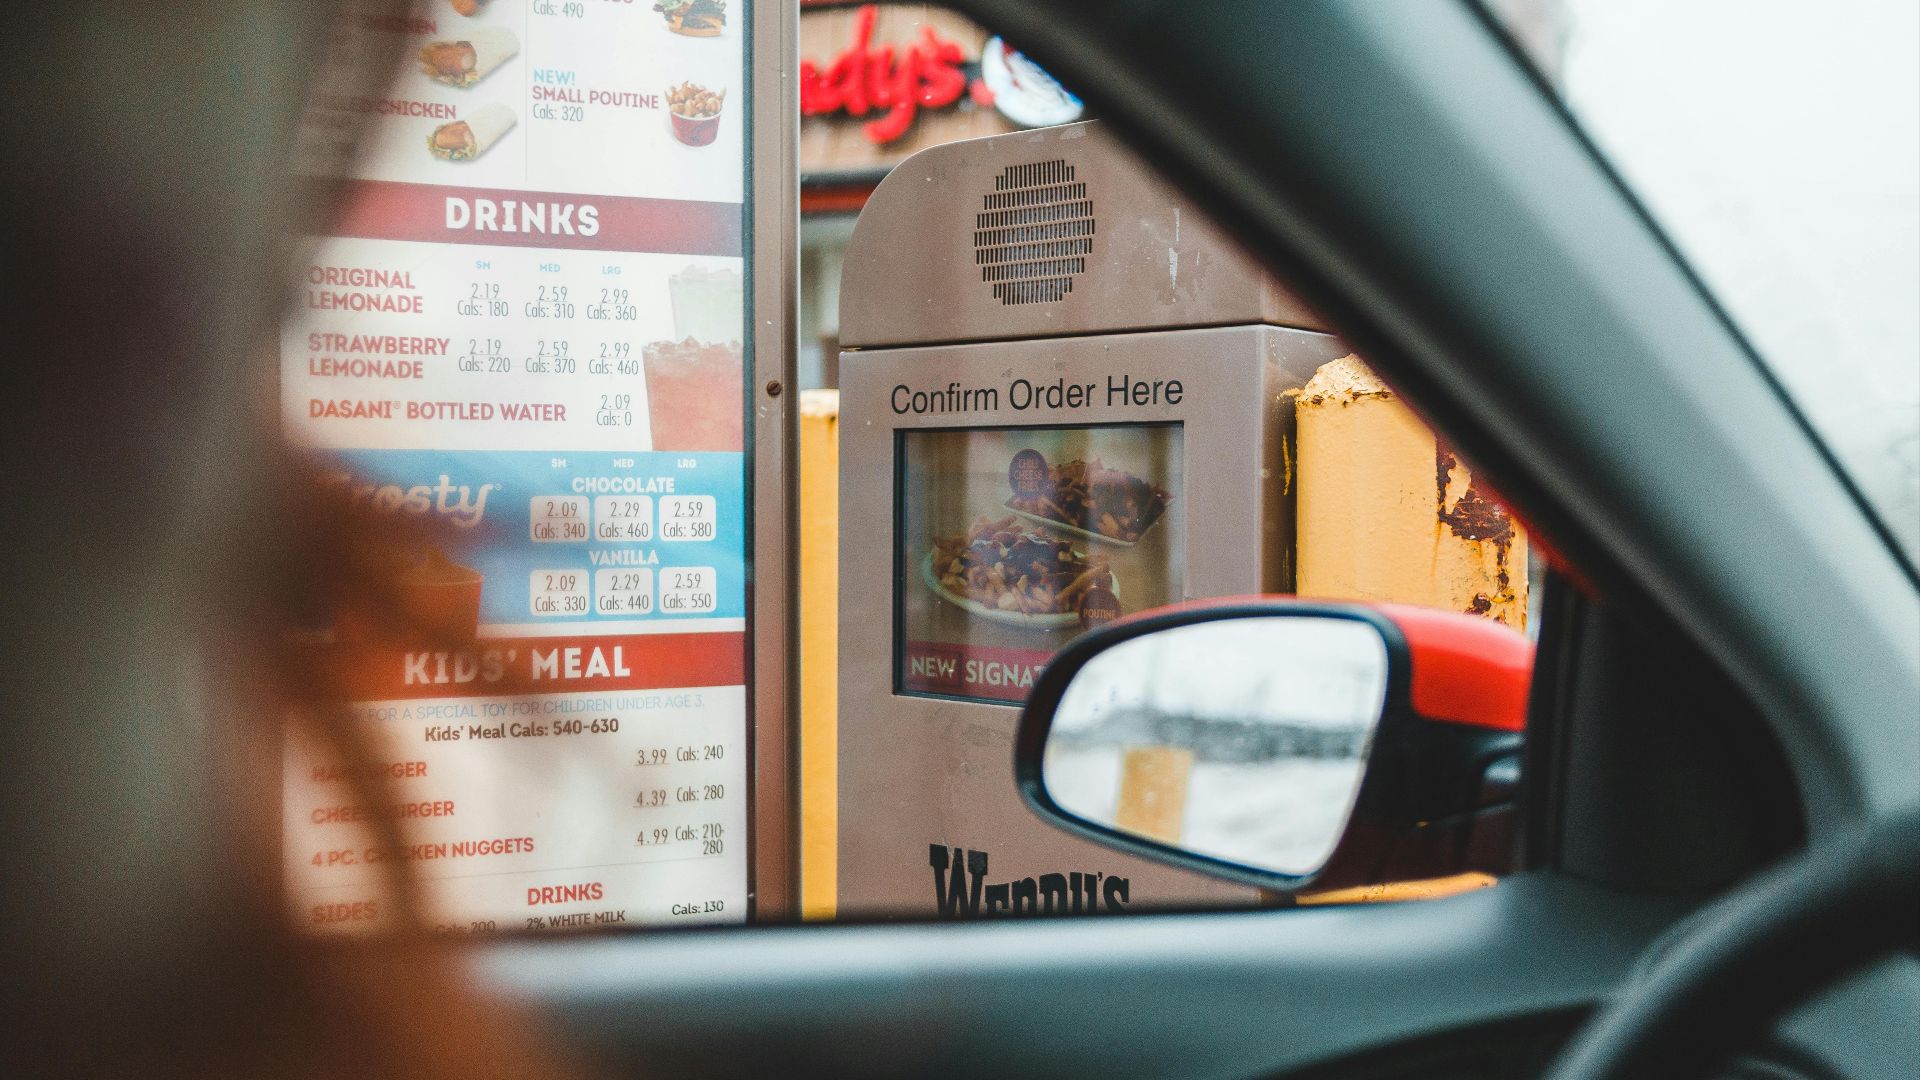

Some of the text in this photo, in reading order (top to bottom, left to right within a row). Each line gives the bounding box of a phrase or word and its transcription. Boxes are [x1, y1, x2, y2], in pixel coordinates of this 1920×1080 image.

[562, 1, 584, 19] 490
[533, 69, 576, 86] NEW!
[532, 85, 659, 109] SMALL POUTINE
[532, 104, 584, 122] Cals: 320
[445, 197, 600, 237] DRINKS
[476, 261, 490, 270] SM
[540, 263, 560, 273] MED
[602, 265, 621, 275] LRG
[309, 265, 415, 290] ORIGINAL
[471, 283, 499, 300] 2.19
[538, 286, 567, 303] 2.59
[601, 289, 629, 305] 2.99
[308, 290, 423, 314] LEMONADE
[457, 301, 509, 318] Cals: 180
[525, 302, 575, 319] Cals: 310
[587, 304, 637, 321] Cals: 360
[309, 333, 450, 357] STRAWBERRY
[470, 339, 502, 356] 2.19
[538, 340, 568, 357] 2.59
[600, 343, 630, 359] 2.99
[309, 358, 423, 379] LEMONADE
[458, 356, 511, 373] Cals: 220
[525, 357, 576, 374] Cals: 370
[588, 359, 639, 376] Cals: 460
[601, 394, 630, 411] 2.09
[891, 375, 1183, 414] Confirm Order Here
[407, 402, 494, 421] BOTTLED
[501, 403, 566, 422] WATER
[596, 410, 632, 427] Cals: 0
[551, 458, 567, 468] SM
[613, 458, 634, 469] MED
[677, 458, 696, 469] LRG
[572, 477, 675, 494] CHOCOLATE
[546, 502, 577, 518] 2.09
[610, 502, 640, 518] 2.29
[674, 502, 703, 518] 2.59
[534, 522, 586, 539] Cals: 340
[599, 522, 649, 539] Cals: 460
[663, 521, 712, 538] Cals: 580
[589, 549, 659, 566] VANILLA
[545, 575, 576, 592] 2.09
[611, 575, 640, 591] 2.29
[674, 573, 702, 590] 2.59
[535, 596, 586, 613] Cals: 330
[599, 594, 650, 611] Cals: 440
[663, 593, 712, 609] Cals: 550
[404, 646, 631, 685] KIDS' MEAL
[911, 656, 956, 678] NEW
[368, 708, 398, 722] FOR
[402, 707, 413, 720] A
[416, 704, 478, 720] SPECIAL
[481, 703, 508, 718] TOY
[512, 701, 540, 716] FOR
[544, 698, 612, 714] CHILDREN
[615, 697, 662, 712] UNDER
[665, 695, 692, 710] AGE
[425, 718, 619, 743] Kids' Meal Cals: 540-630
[637, 749, 667, 765] 3.99
[676, 744, 724, 762] Cals: 240
[312, 761, 427, 781] HAGER
[636, 790, 667, 807] 4.39
[676, 785, 724, 803] Cals: 280
[311, 801, 455, 825] CHEERGER
[636, 829, 668, 846] 4.99
[675, 823, 724, 841] Cals: 210-
[311, 837, 534, 867] 4 PC. CKEN NUGGETS
[703, 839, 723, 855] 280
[528, 882, 603, 906] DRINKS
[312, 902, 377, 922] SIDES
[672, 900, 724, 916] Cals: 130
[527, 909, 625, 930] 2% WHITE MILK
